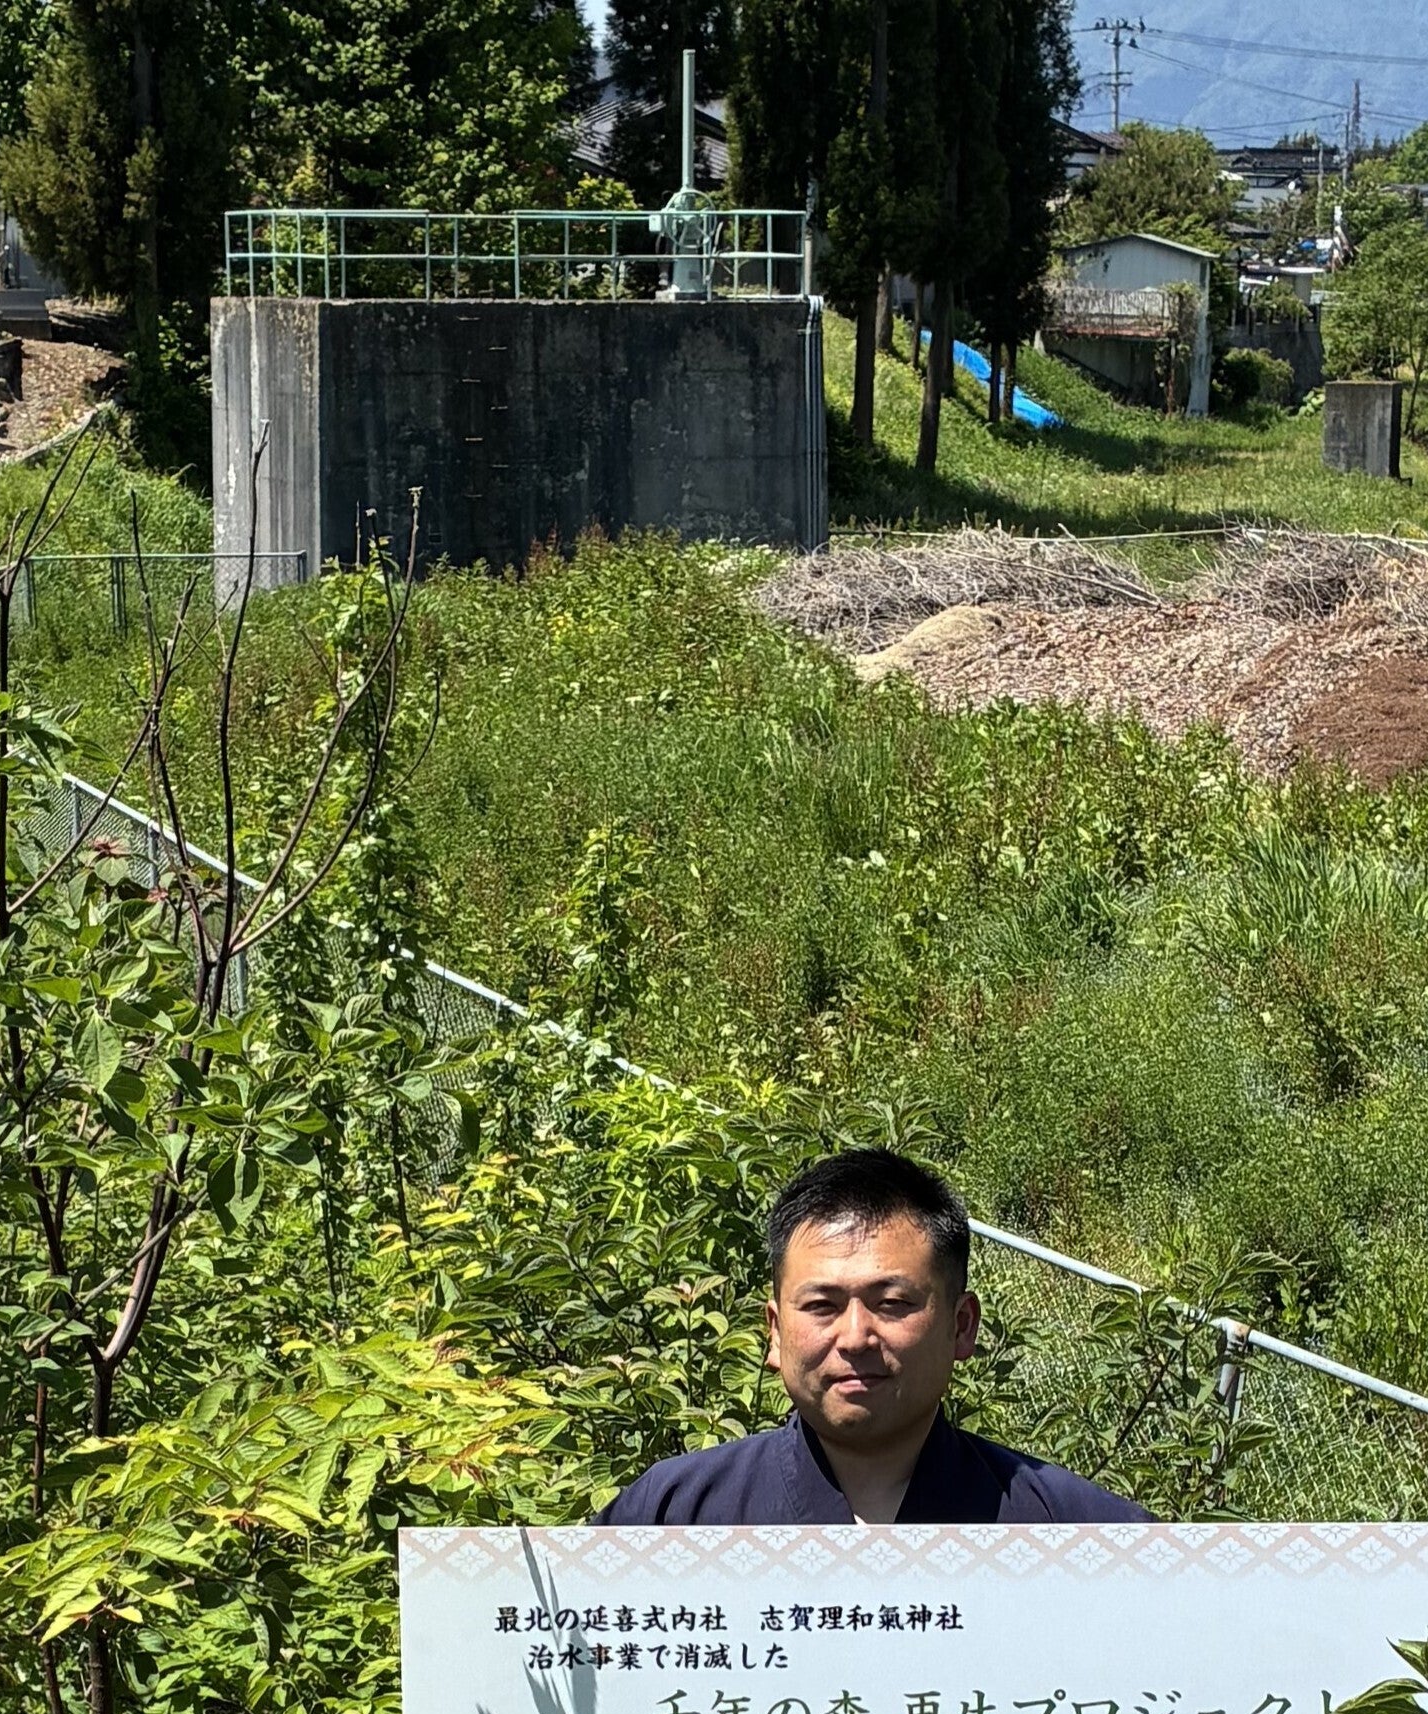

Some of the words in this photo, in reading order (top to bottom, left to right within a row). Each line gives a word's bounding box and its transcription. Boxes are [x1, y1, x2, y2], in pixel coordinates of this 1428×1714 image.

[494, 1604, 728, 1633] 最北の延喜式内社
[760, 1604, 964, 1631] 志賀理和氣神社
[528, 1642, 789, 1670] 治水事業で消滅した
